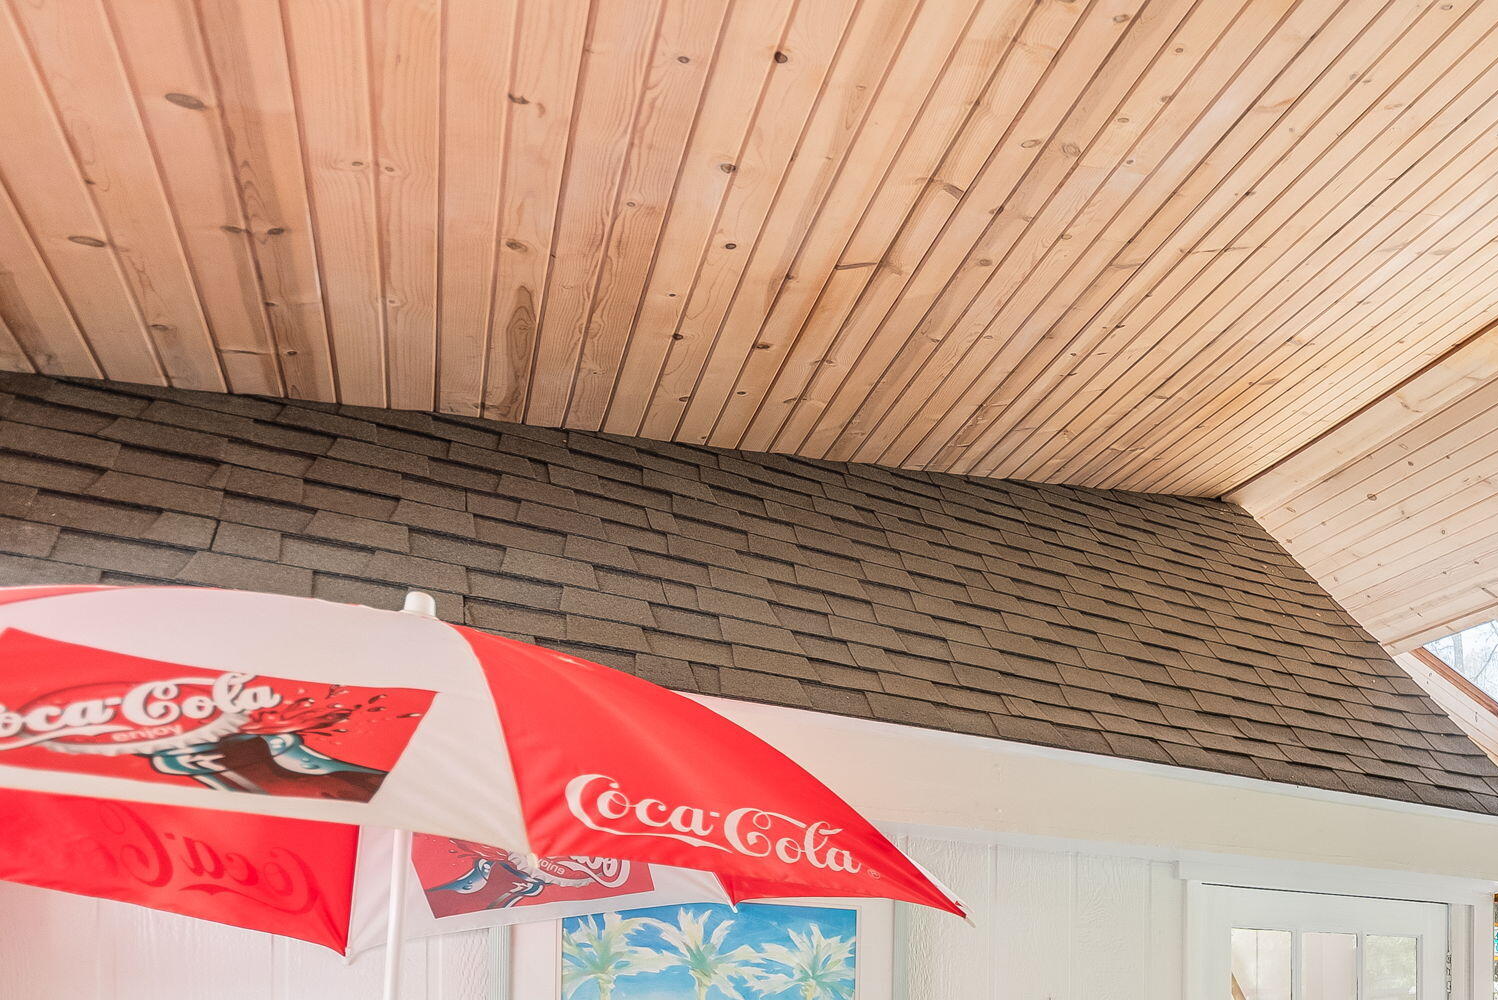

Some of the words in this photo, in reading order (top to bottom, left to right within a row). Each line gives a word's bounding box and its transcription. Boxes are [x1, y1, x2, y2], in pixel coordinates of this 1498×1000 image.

[0, 672, 281, 750] oca-Cola
[111, 723, 183, 743] enjoy
[565, 773, 862, 874] Coca-Cola
